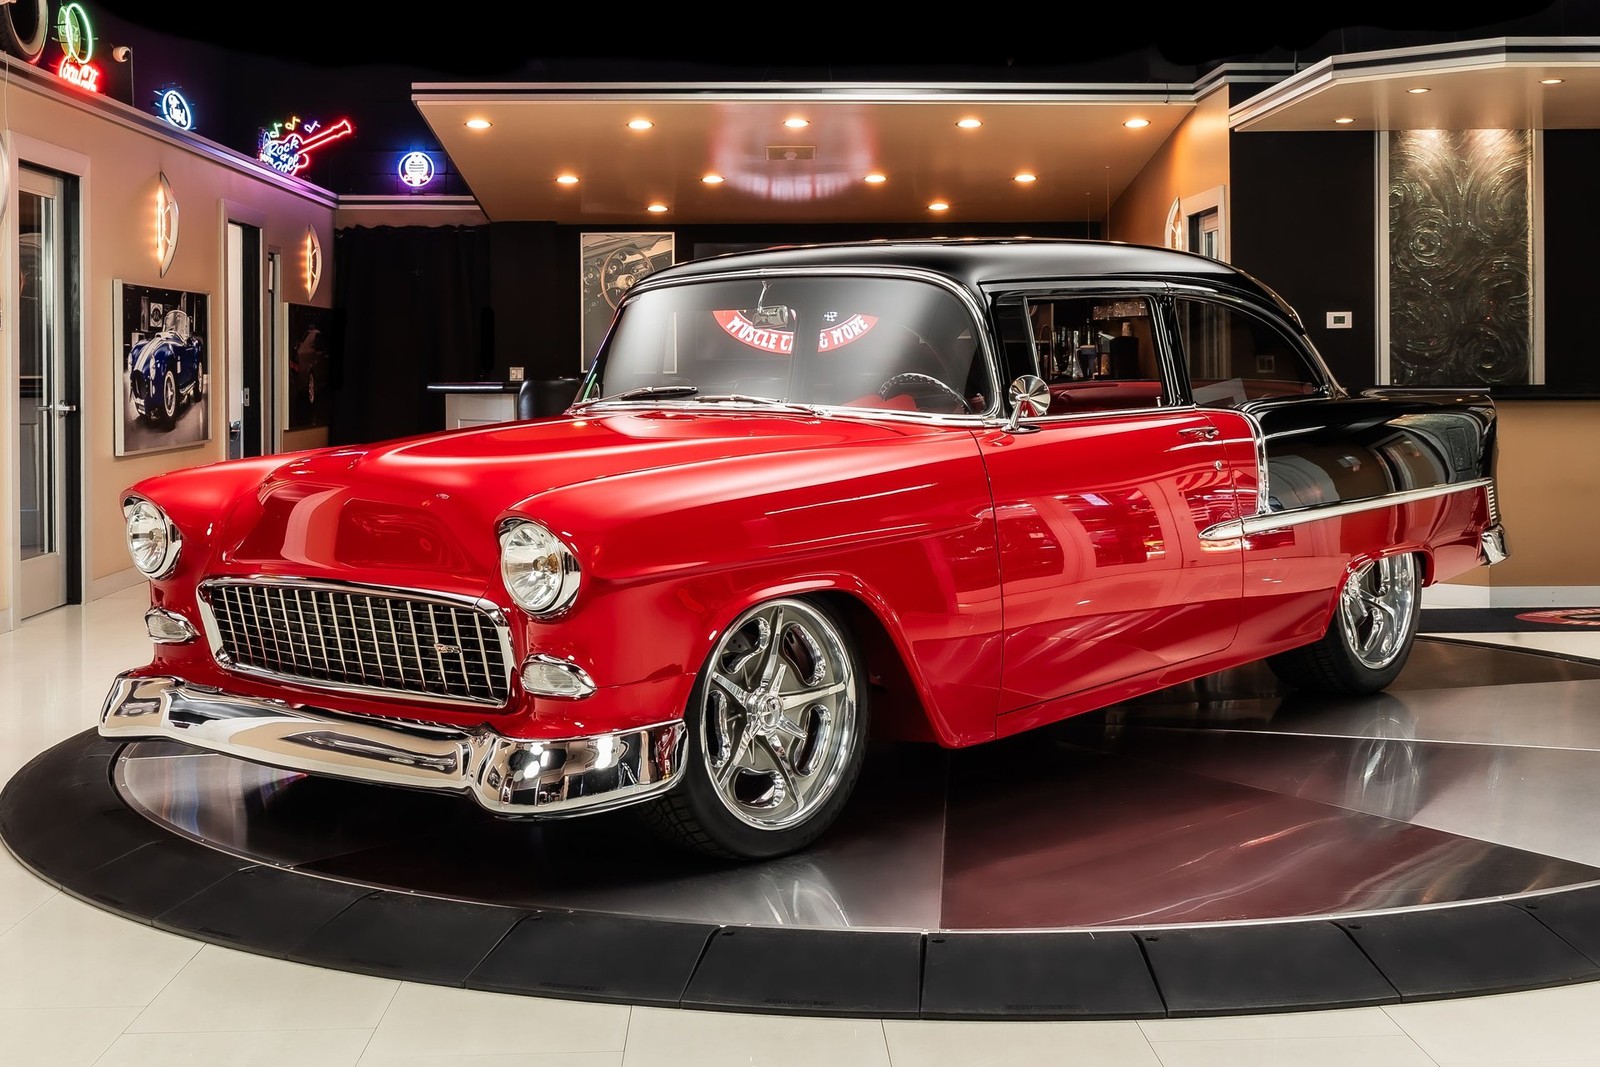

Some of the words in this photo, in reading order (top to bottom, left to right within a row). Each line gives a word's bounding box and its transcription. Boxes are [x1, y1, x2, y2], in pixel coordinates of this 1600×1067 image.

[269, 136, 299, 157] Rock
[726, 315, 779, 350] MUSCLE
[830, 314, 869, 346] MORE
